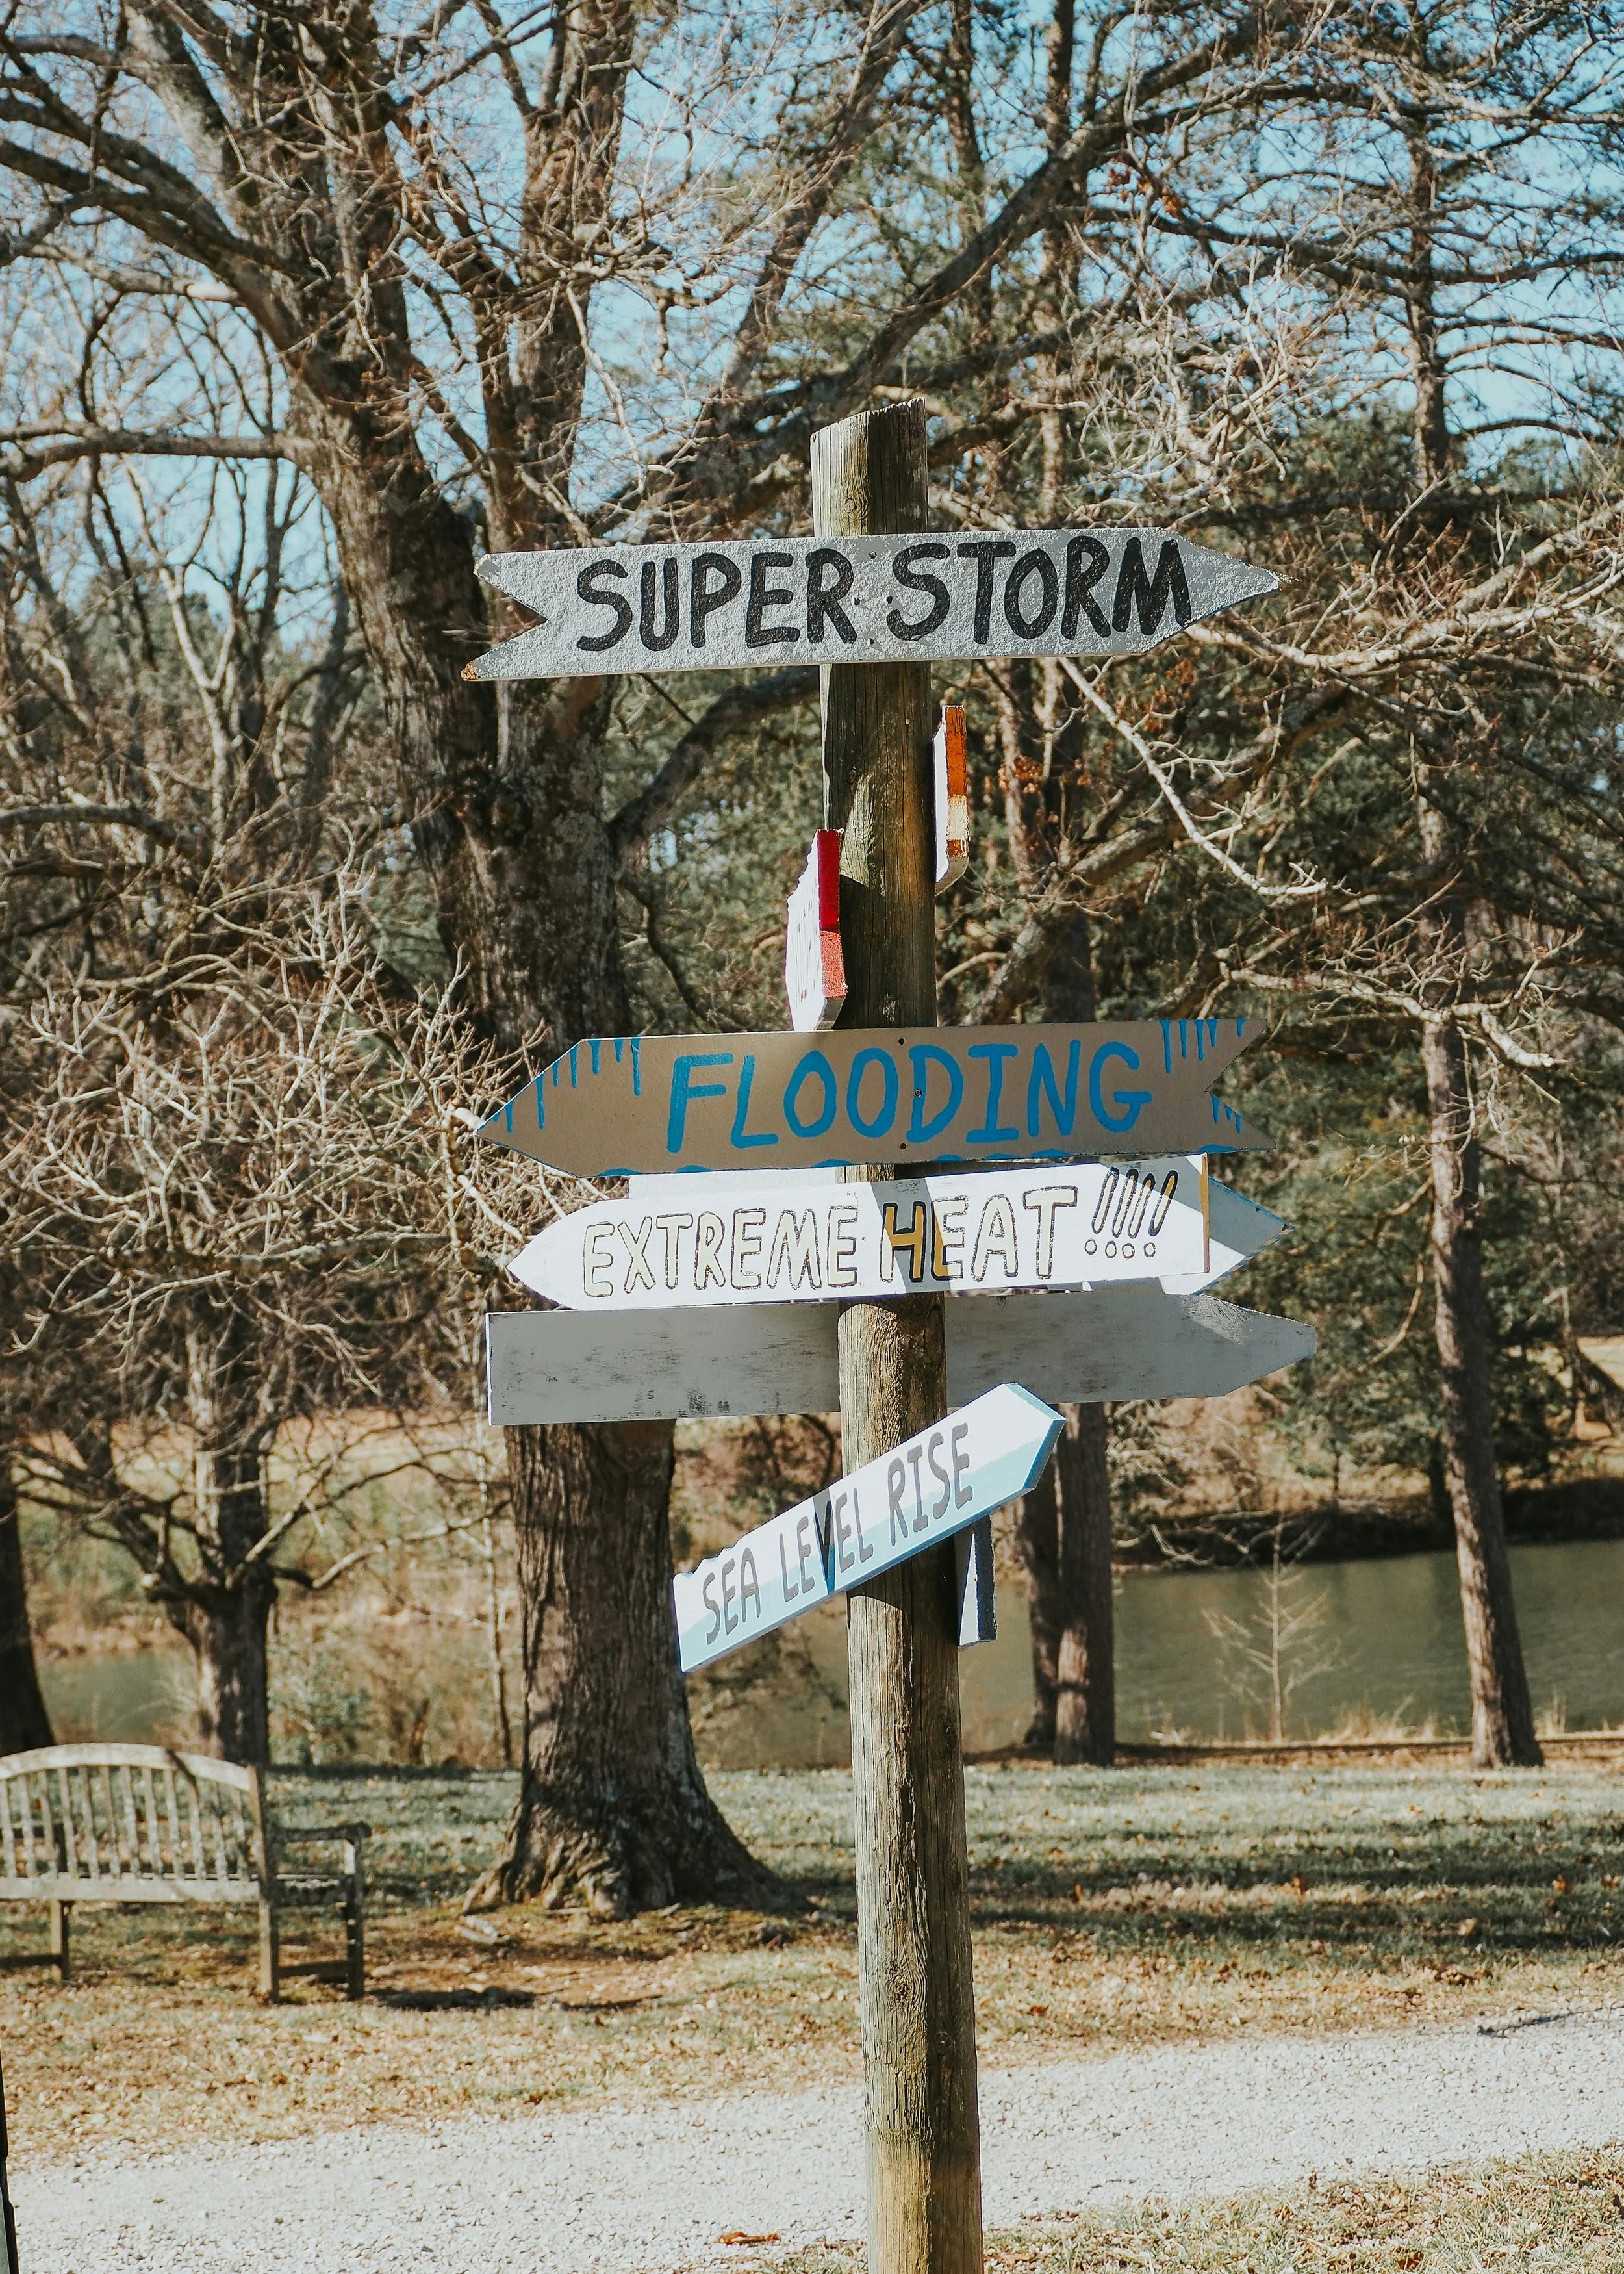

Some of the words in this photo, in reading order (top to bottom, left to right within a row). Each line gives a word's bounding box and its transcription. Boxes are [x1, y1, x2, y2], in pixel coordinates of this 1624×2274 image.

[576, 548, 857, 651] SUPER
[885, 535, 1193, 645] STORM
[666, 1038, 1152, 1153] FLOODING
[583, 1207, 858, 1297] EXTREME
[701, 1546, 762, 1646] SEA
[778, 1488, 874, 1603] LEVEL
[887, 1422, 974, 1548] RISE
